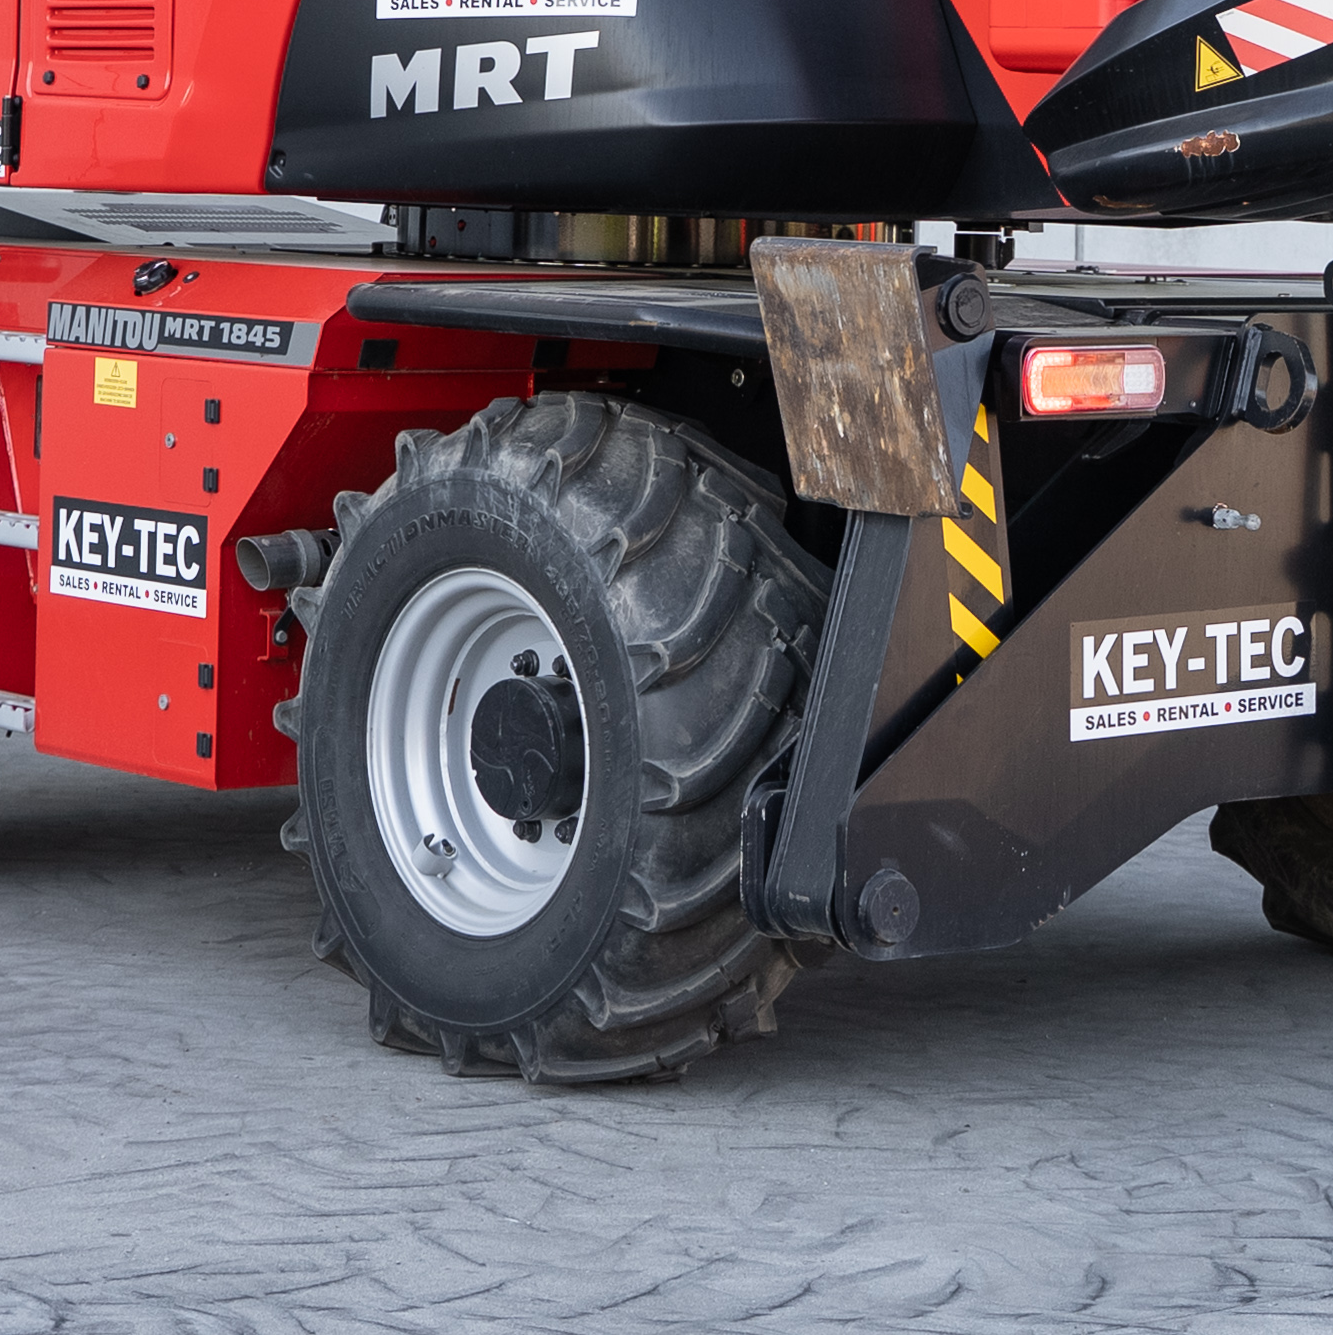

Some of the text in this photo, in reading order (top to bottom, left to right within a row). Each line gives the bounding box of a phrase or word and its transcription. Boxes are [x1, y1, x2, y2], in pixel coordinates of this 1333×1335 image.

[370, 30, 600, 119] MRT
[47, 303, 281, 350] MANITOU MRT 1845
[58, 508, 200, 581] KEY-TEC
[59, 574, 198, 609] SALES RENTAL SERVICE
[1083, 616, 1305, 699] KEY-TEC
[1086, 692, 1304, 731] SALES RENTAL SERVICE
